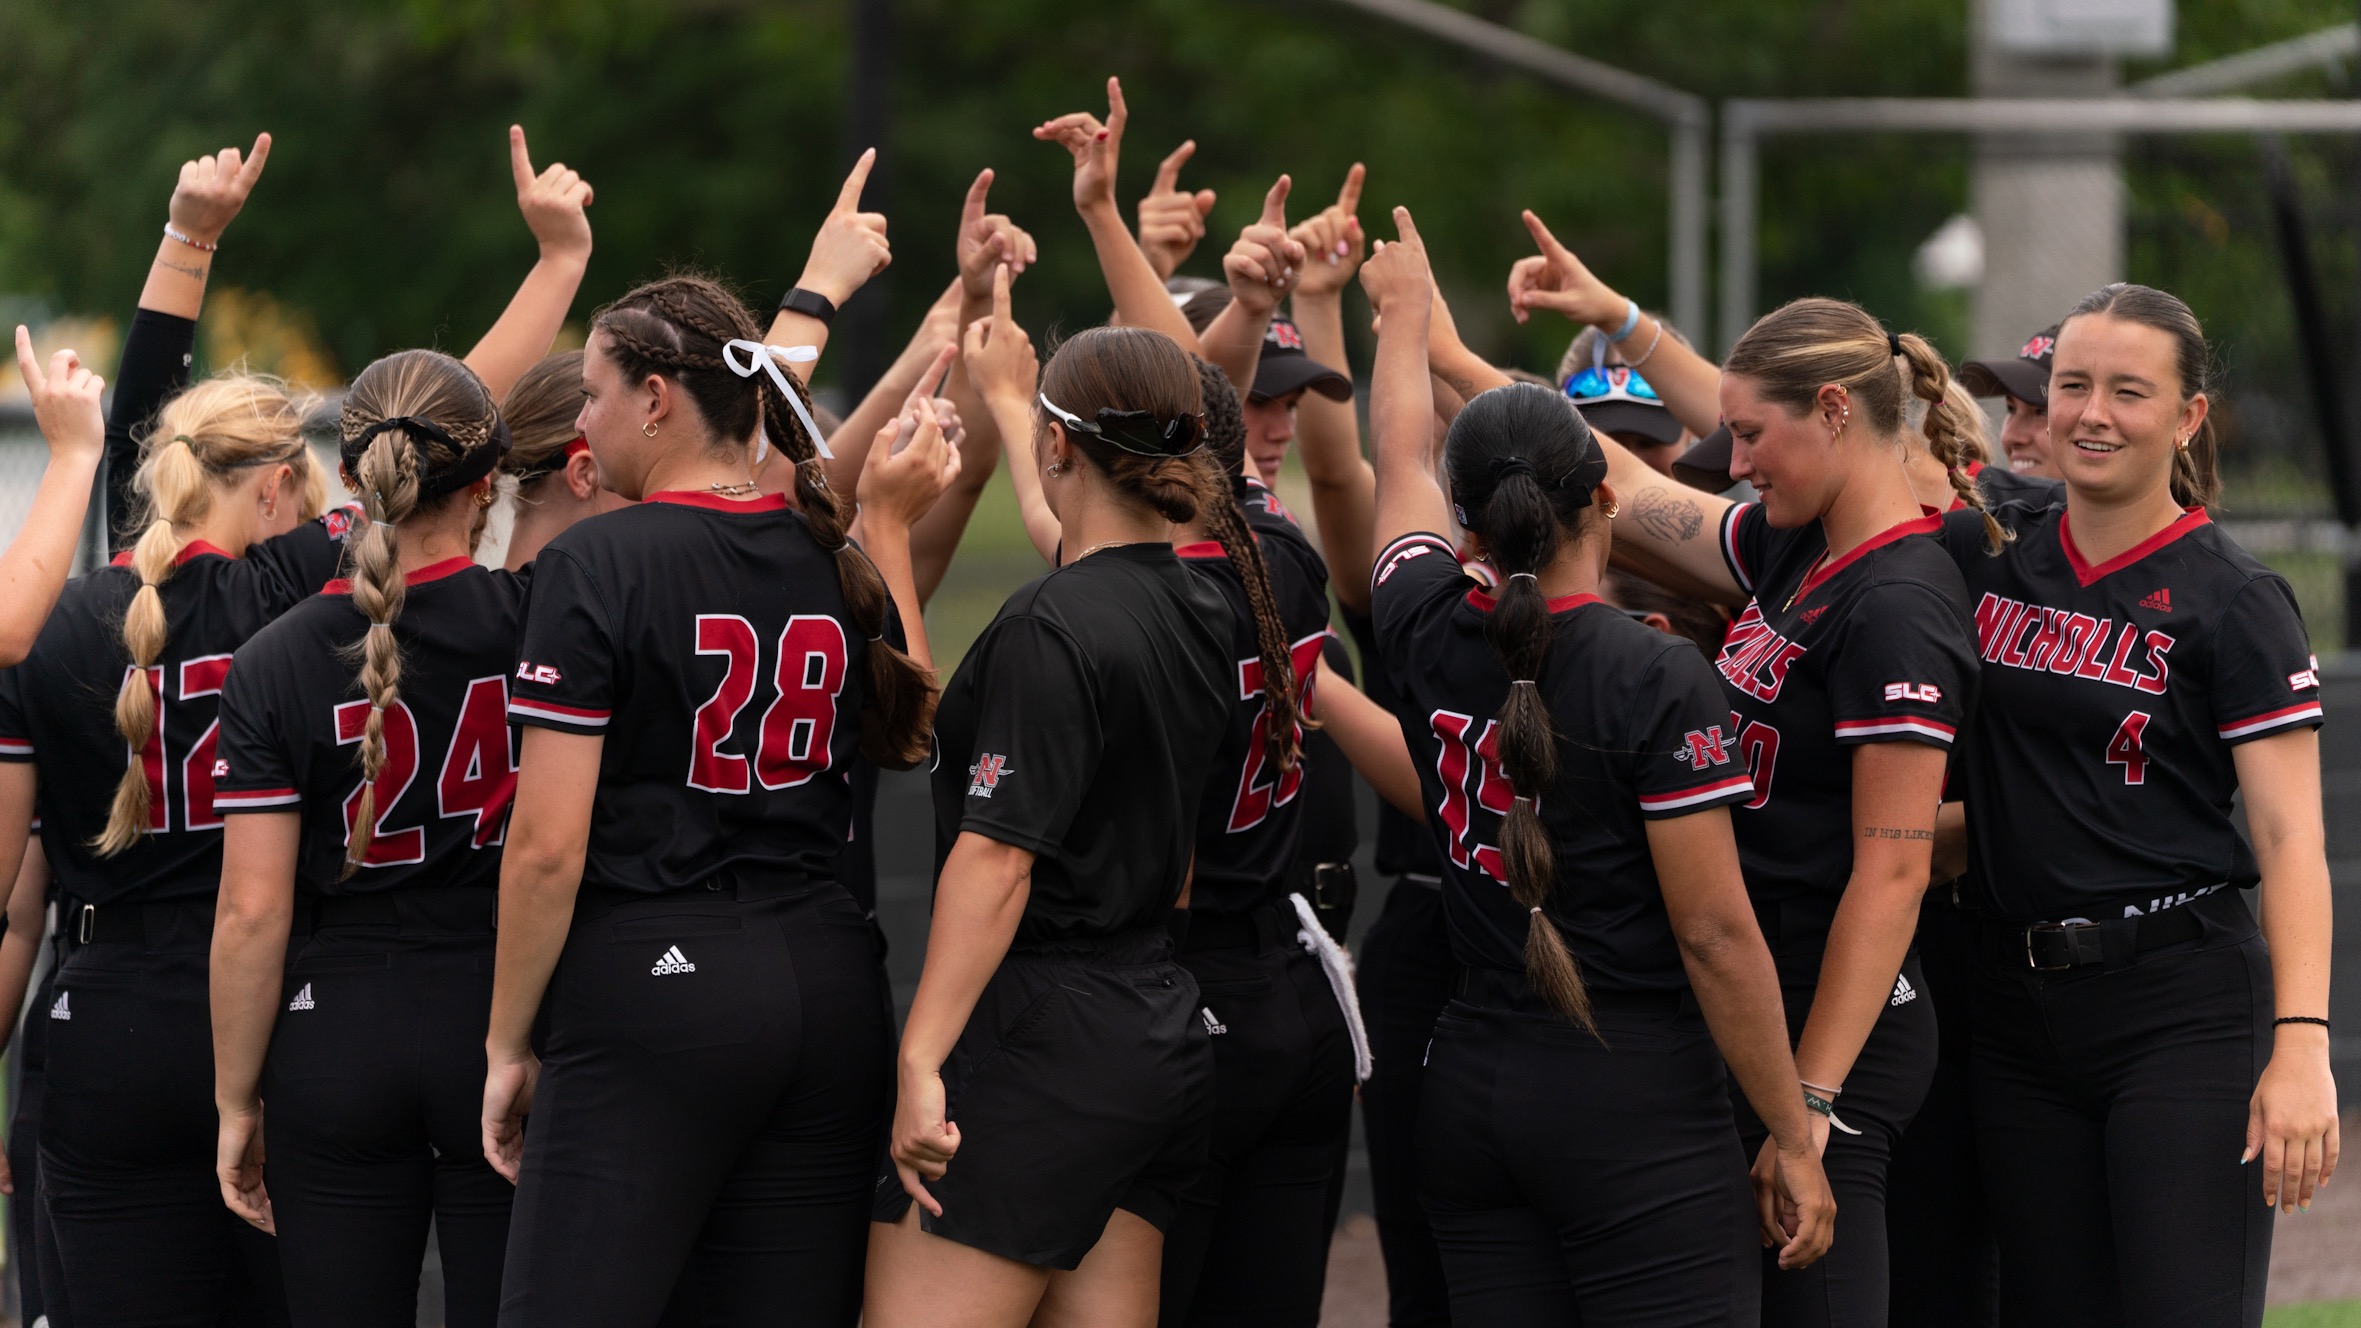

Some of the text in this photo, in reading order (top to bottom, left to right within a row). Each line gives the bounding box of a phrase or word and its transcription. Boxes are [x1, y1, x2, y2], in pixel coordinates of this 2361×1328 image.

[2138, 599, 2173, 613] adidas
[1974, 591, 2176, 695] NICHOLLS
[516, 661, 562, 685] LC
[686, 614, 848, 795] 28
[1684, 725, 1730, 771] N
[2106, 710, 2151, 785] 4
[333, 674, 520, 868] 24
[971, 753, 1007, 788] N
[1864, 827, 1877, 838] IN
[1880, 828, 1902, 839] HIS
[651, 962, 696, 976] adidas
[1891, 989, 1917, 1006] adidas
